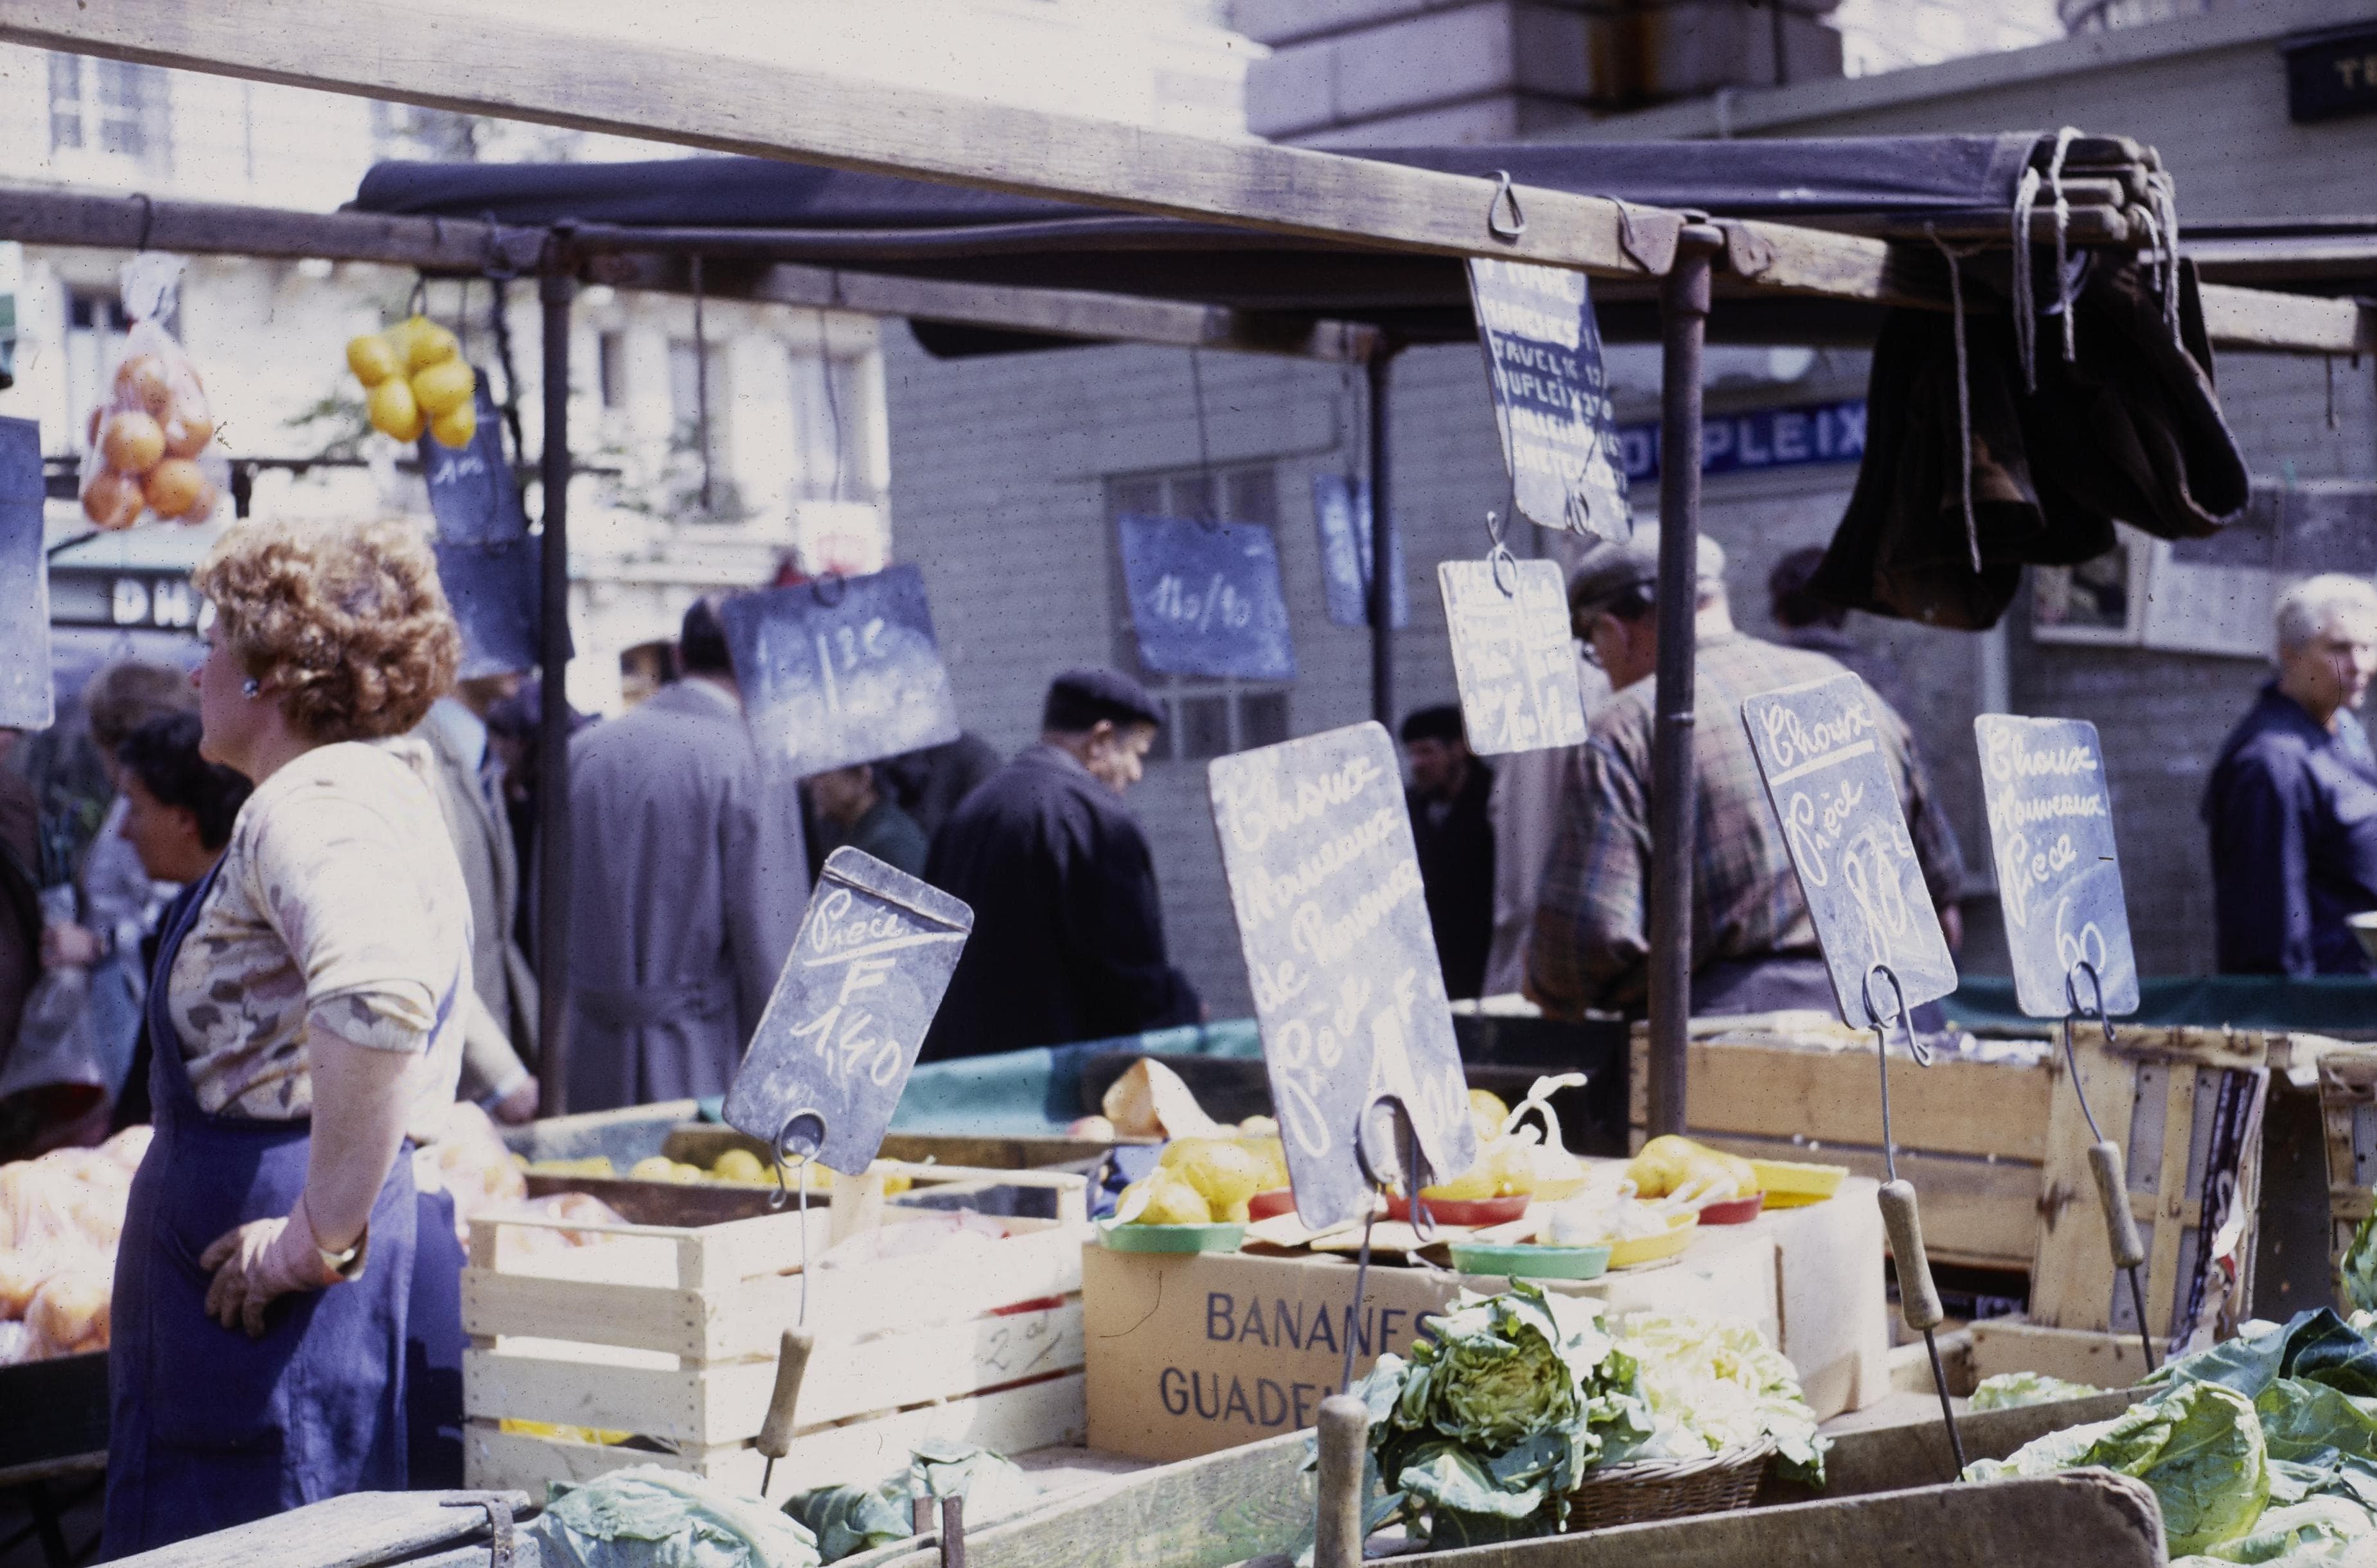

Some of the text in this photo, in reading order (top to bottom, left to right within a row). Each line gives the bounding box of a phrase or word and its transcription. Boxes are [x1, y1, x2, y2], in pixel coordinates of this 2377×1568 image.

[1620, 403, 1867, 477] DPLEIX
[2056, 895, 2107, 978] 60
[839, 957, 896, 1007] F
[1206, 1291, 1445, 1359] BANANES
[1160, 1366, 1335, 1431] GUADE
